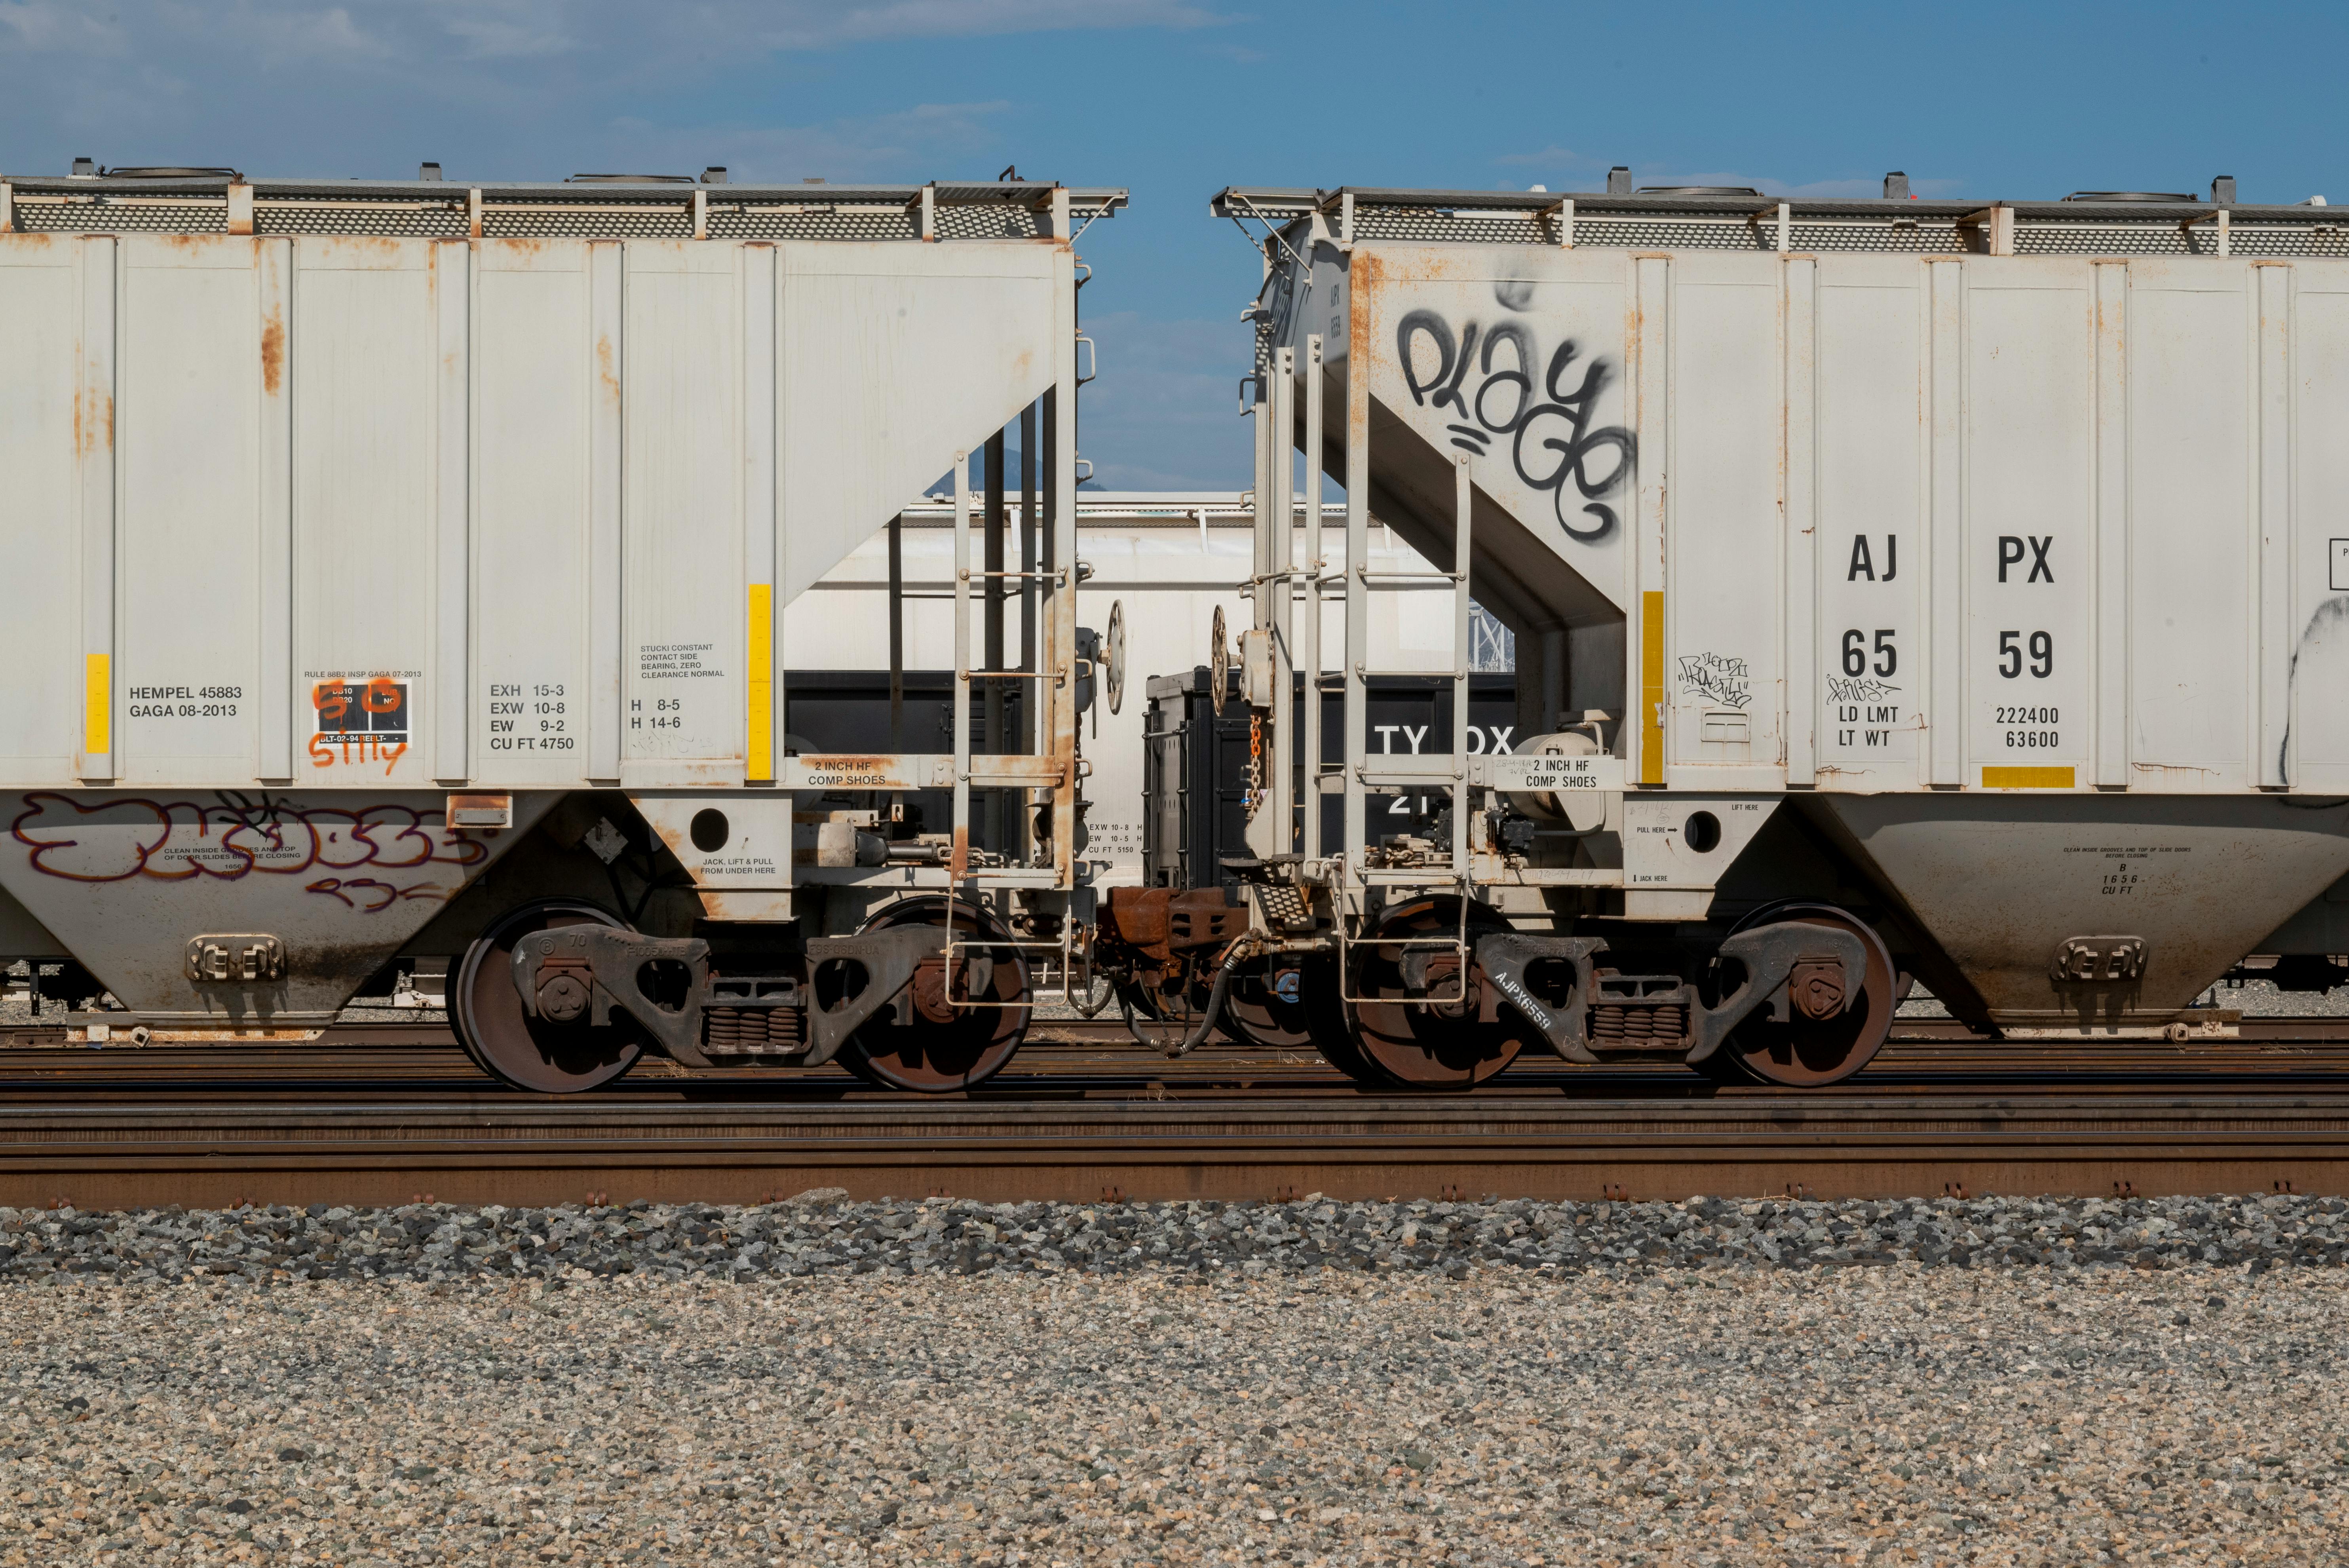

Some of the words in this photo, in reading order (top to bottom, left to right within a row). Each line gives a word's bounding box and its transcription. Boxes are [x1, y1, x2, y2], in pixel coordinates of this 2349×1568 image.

[1847, 534, 1897, 582] AJ
[1998, 536, 2054, 583] PX
[1842, 629, 1897, 677] 65
[1999, 630, 2053, 679] 59
[130, 687, 194, 699] HEMPEL
[199, 686, 242, 698] 45883
[491, 684, 521, 696] EXH
[533, 684, 564, 696] 15-3
[130, 705, 174, 717] GAGA
[179, 705, 236, 716] 08-2013
[491, 703, 524, 714] EXW
[534, 702, 565, 714] 10-8
[631, 699, 641, 711] H
[658, 699, 680, 711] 8-5
[1840, 706, 1858, 722] LD
[1868, 706, 1898, 722] LMT
[1996, 707, 2058, 724] 222400
[491, 720, 514, 732] EW
[541, 720, 564, 732] 9-2
[631, 717, 641, 728] H
[650, 717, 680, 728] 14-6
[491, 738, 512, 749] CU
[518, 738, 535, 749] FT
[540, 737, 574, 749] 4750
[1839, 730, 1855, 745] LT
[1865, 730, 1889, 746] WT
[2006, 731, 2058, 747] 63600
[815, 762, 821, 770] 2
[825, 762, 853, 770] INCH
[857, 762, 871, 770] HF
[1534, 760, 1540, 771] 2
[1546, 760, 1570, 771] INCH
[1576, 760, 1589, 771] HF
[809, 776, 843, 785] COMP
[847, 775, 885, 785] SHOES
[1526, 775, 1556, 787] COMP
[1563, 776, 1596, 787] SHOES
[2119, 863, 2127, 872] B
[1495, 972, 1551, 1029] AJPX6559
